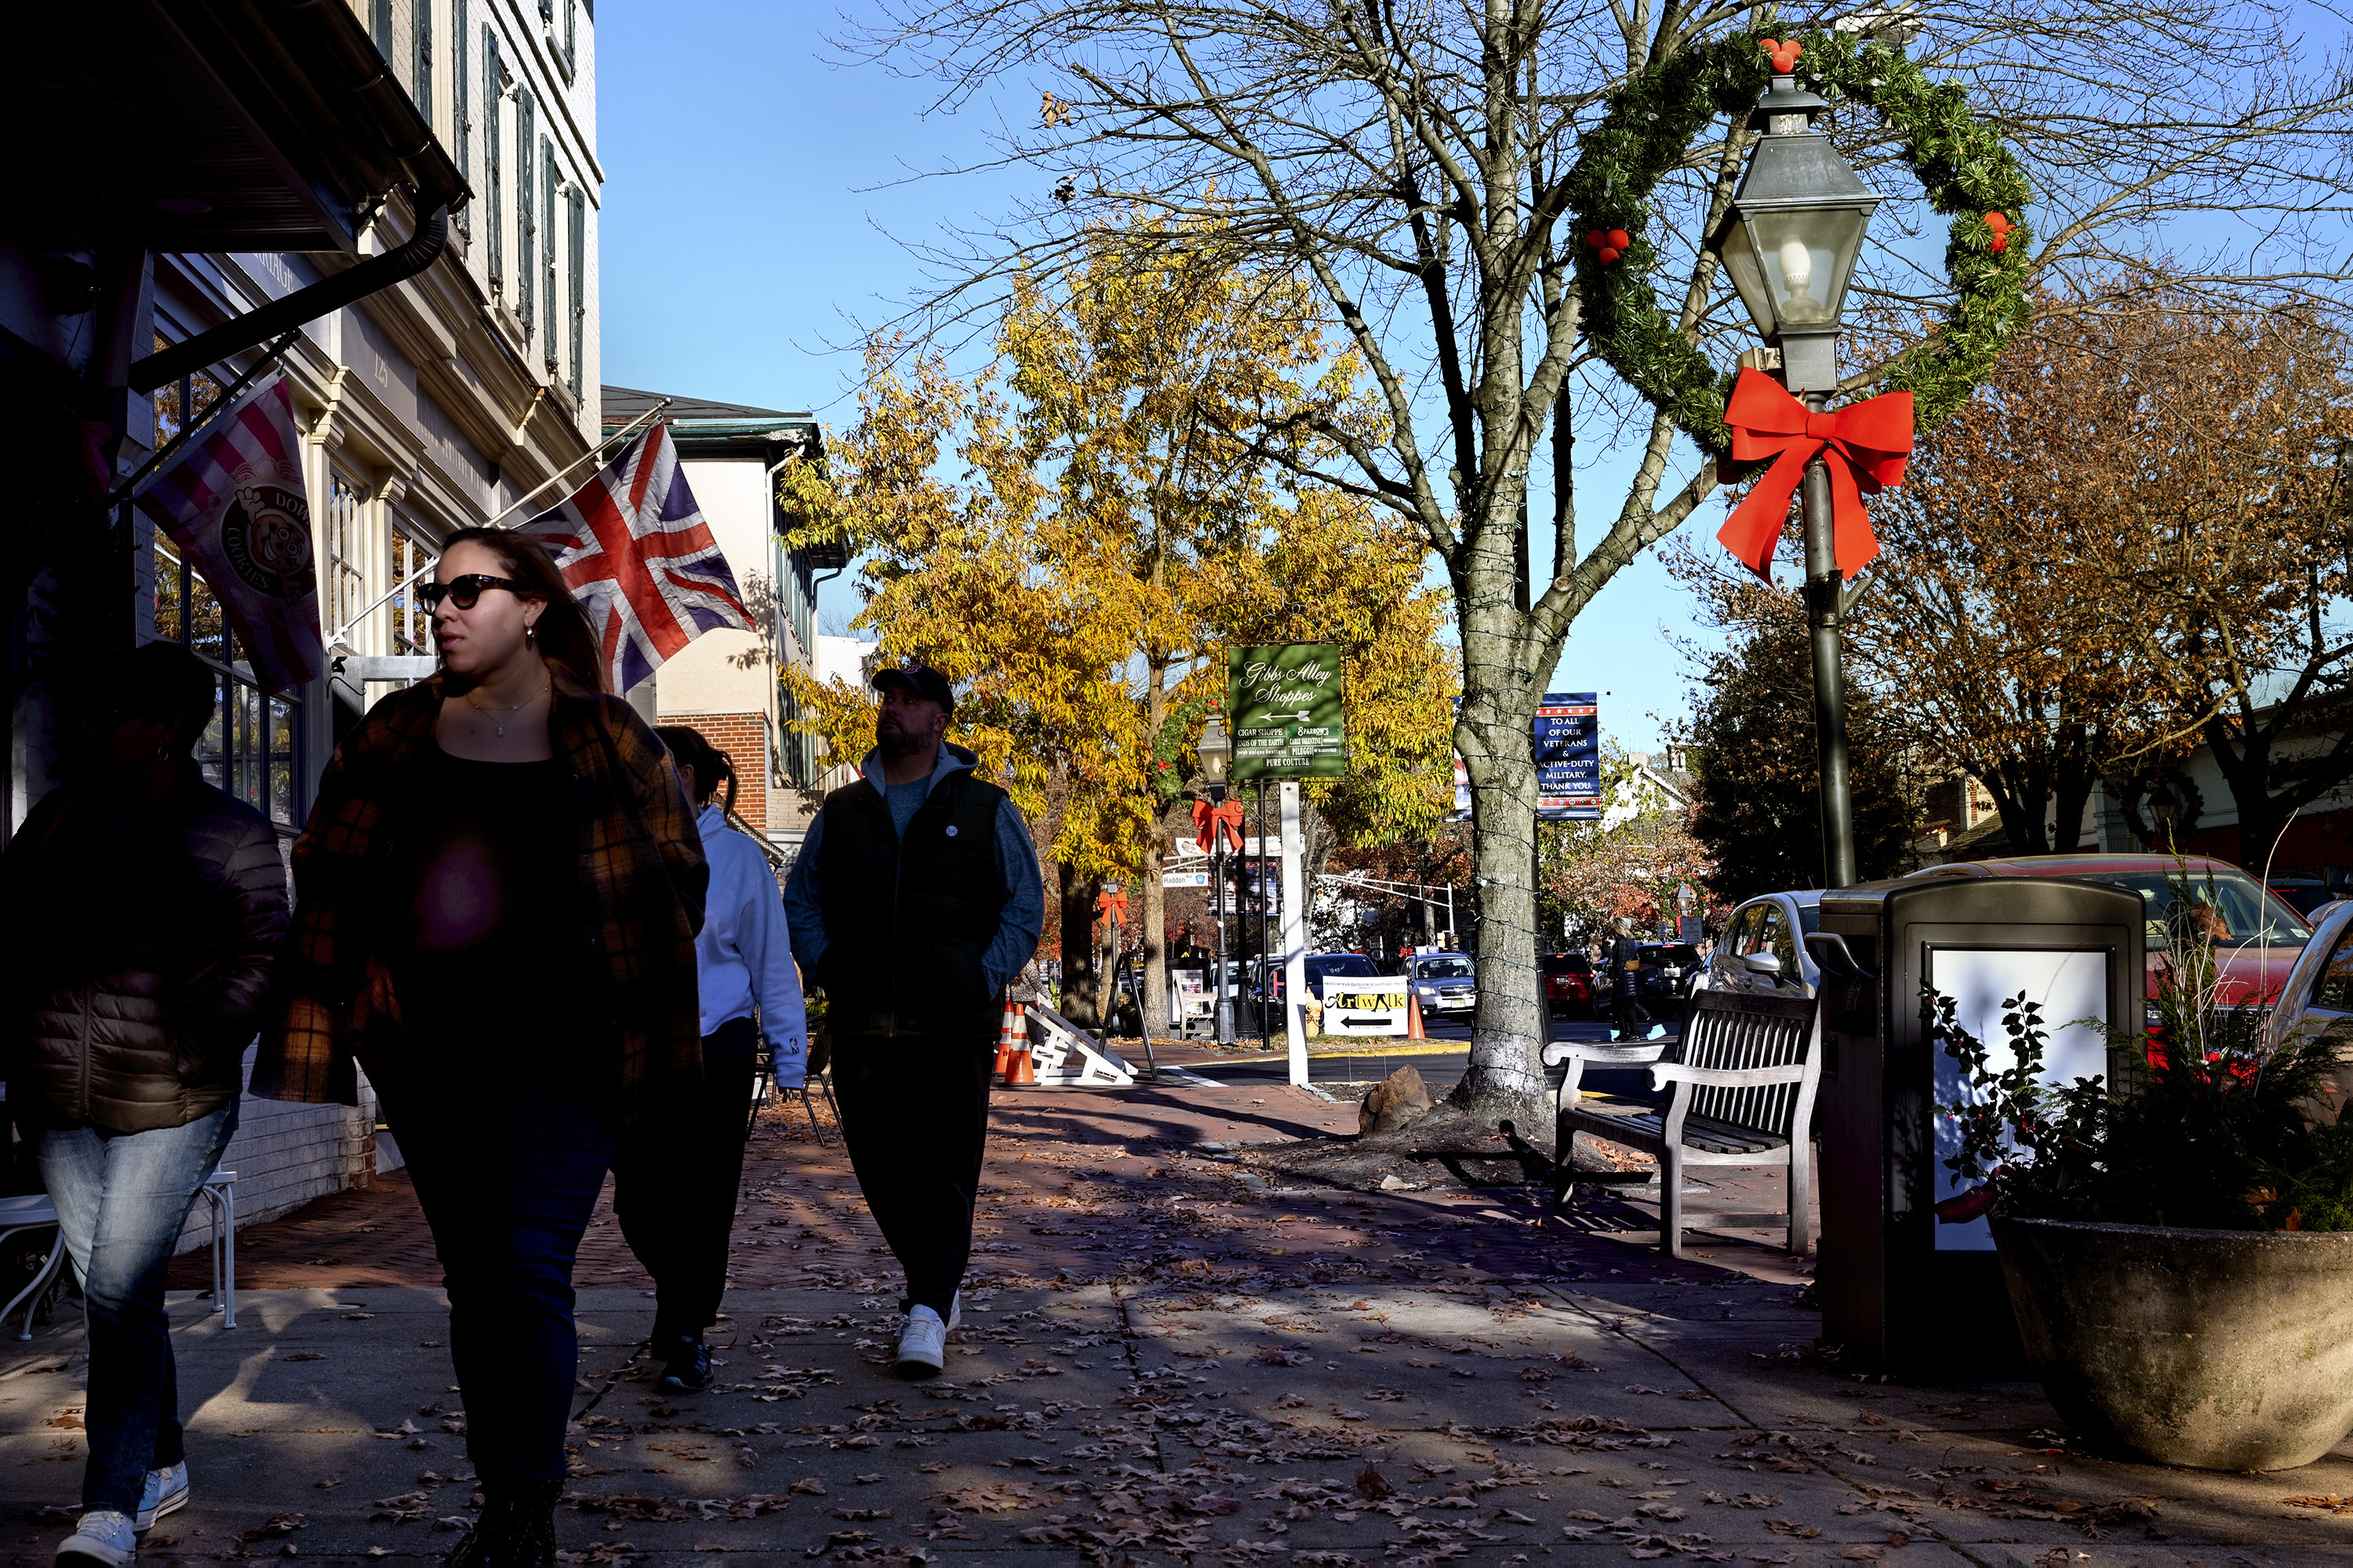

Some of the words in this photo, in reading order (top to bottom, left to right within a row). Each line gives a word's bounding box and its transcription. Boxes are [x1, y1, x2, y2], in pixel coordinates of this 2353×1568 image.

[374, 351, 388, 388] 125
[227, 527, 270, 589] COOKIES
[1238, 660, 1285, 689] Gibbs
[1286, 660, 1332, 688] Alley
[1253, 682, 1317, 708] Shoppes
[1292, 747, 1312, 755] PILEGGI
[1282, 758, 1310, 766] COUTURE
[1538, 760, 1595, 769] ACTIVE-DUTY
[1163, 875, 1186, 884] Haddon
